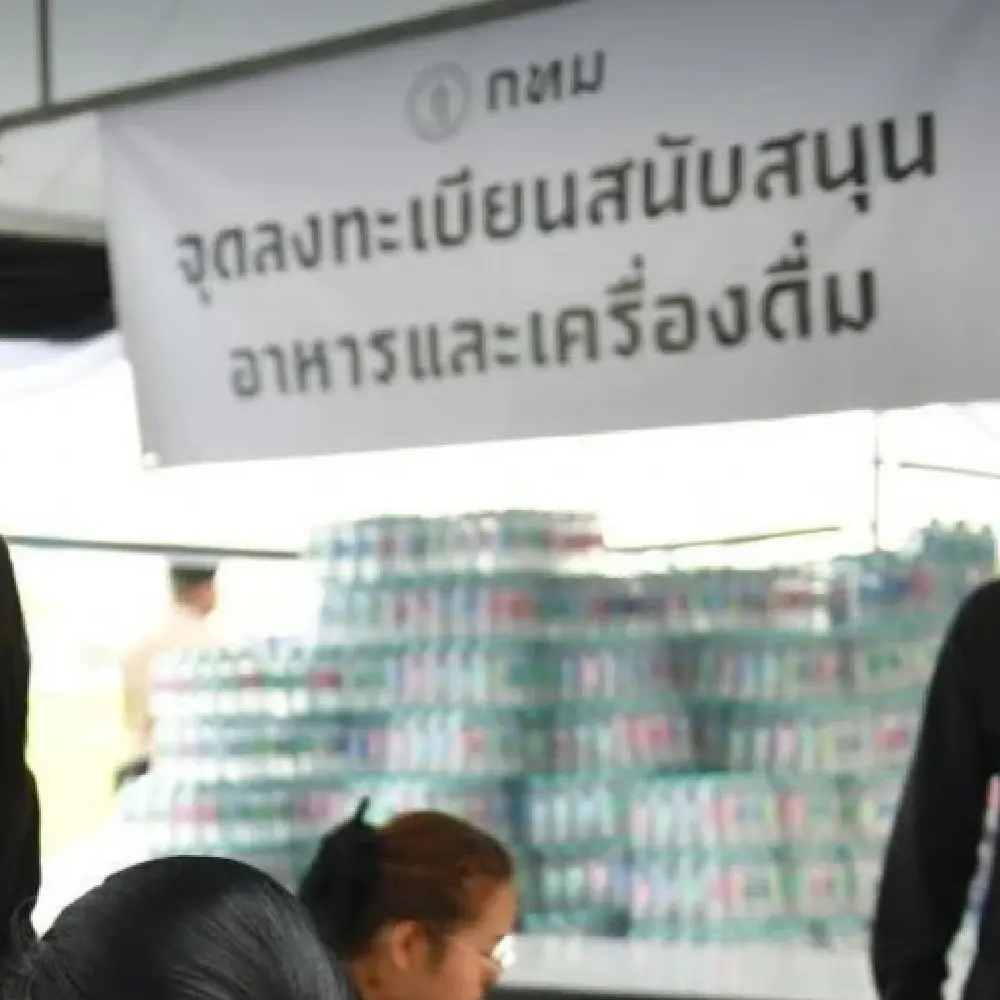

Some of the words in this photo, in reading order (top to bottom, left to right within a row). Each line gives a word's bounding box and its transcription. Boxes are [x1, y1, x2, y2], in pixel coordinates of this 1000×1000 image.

[175, 110, 938, 306] จุดลงทะเบียนสนับสนุน
[229, 231, 878, 400] อาหารและเครื่องดื่ม
